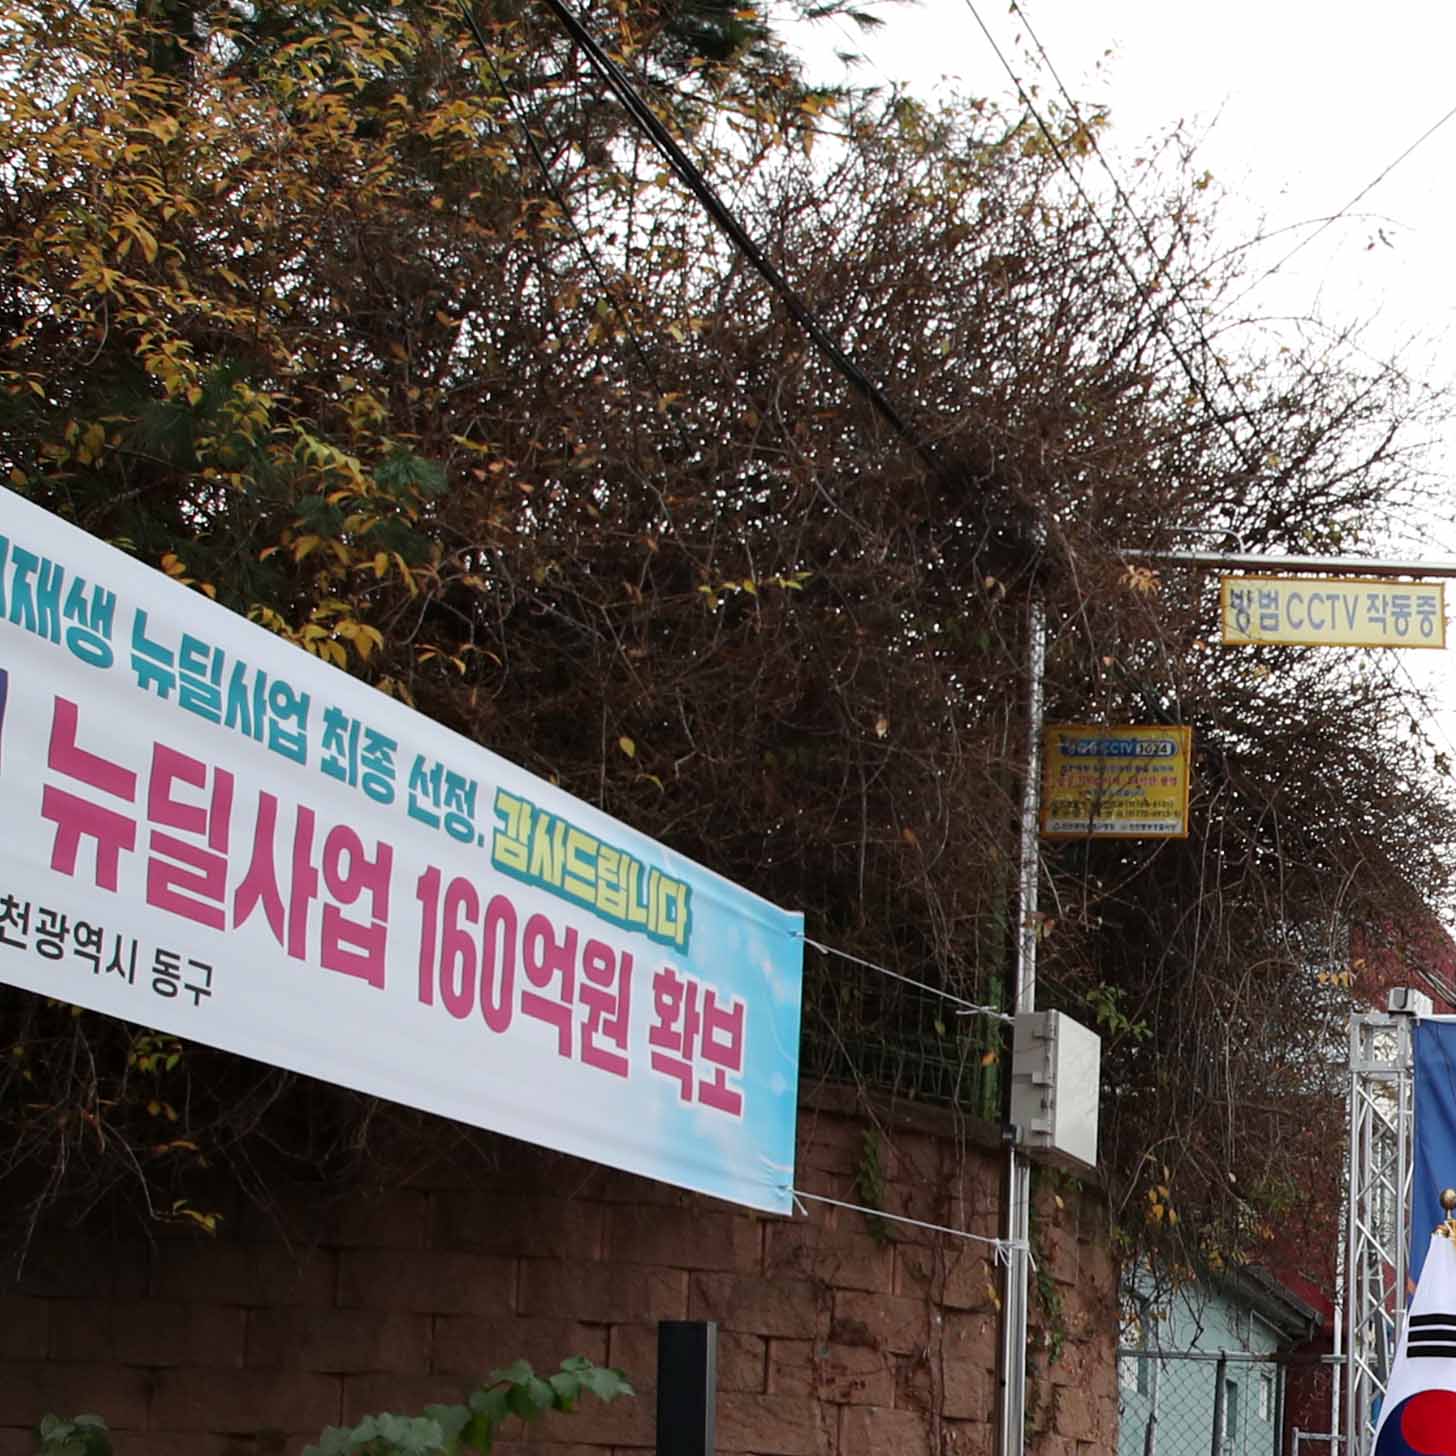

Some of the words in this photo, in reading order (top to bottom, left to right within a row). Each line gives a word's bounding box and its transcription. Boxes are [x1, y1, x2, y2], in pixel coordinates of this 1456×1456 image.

[1286, 591, 1359, 630] CCTV
[1367, 593, 1437, 637] 작동중
[0, 535, 116, 669] 재생
[129, 609, 312, 766] 뉴딜사업
[318, 705, 400, 806] 최종
[406, 752, 486, 849] 선정.
[494, 788, 691, 952] 감사드립니다
[41, 695, 394, 990] 뉴딜사업
[415, 866, 635, 1080] 160억원
[649, 964, 748, 1118] 확보
[152, 948, 213, 1006] 동구
